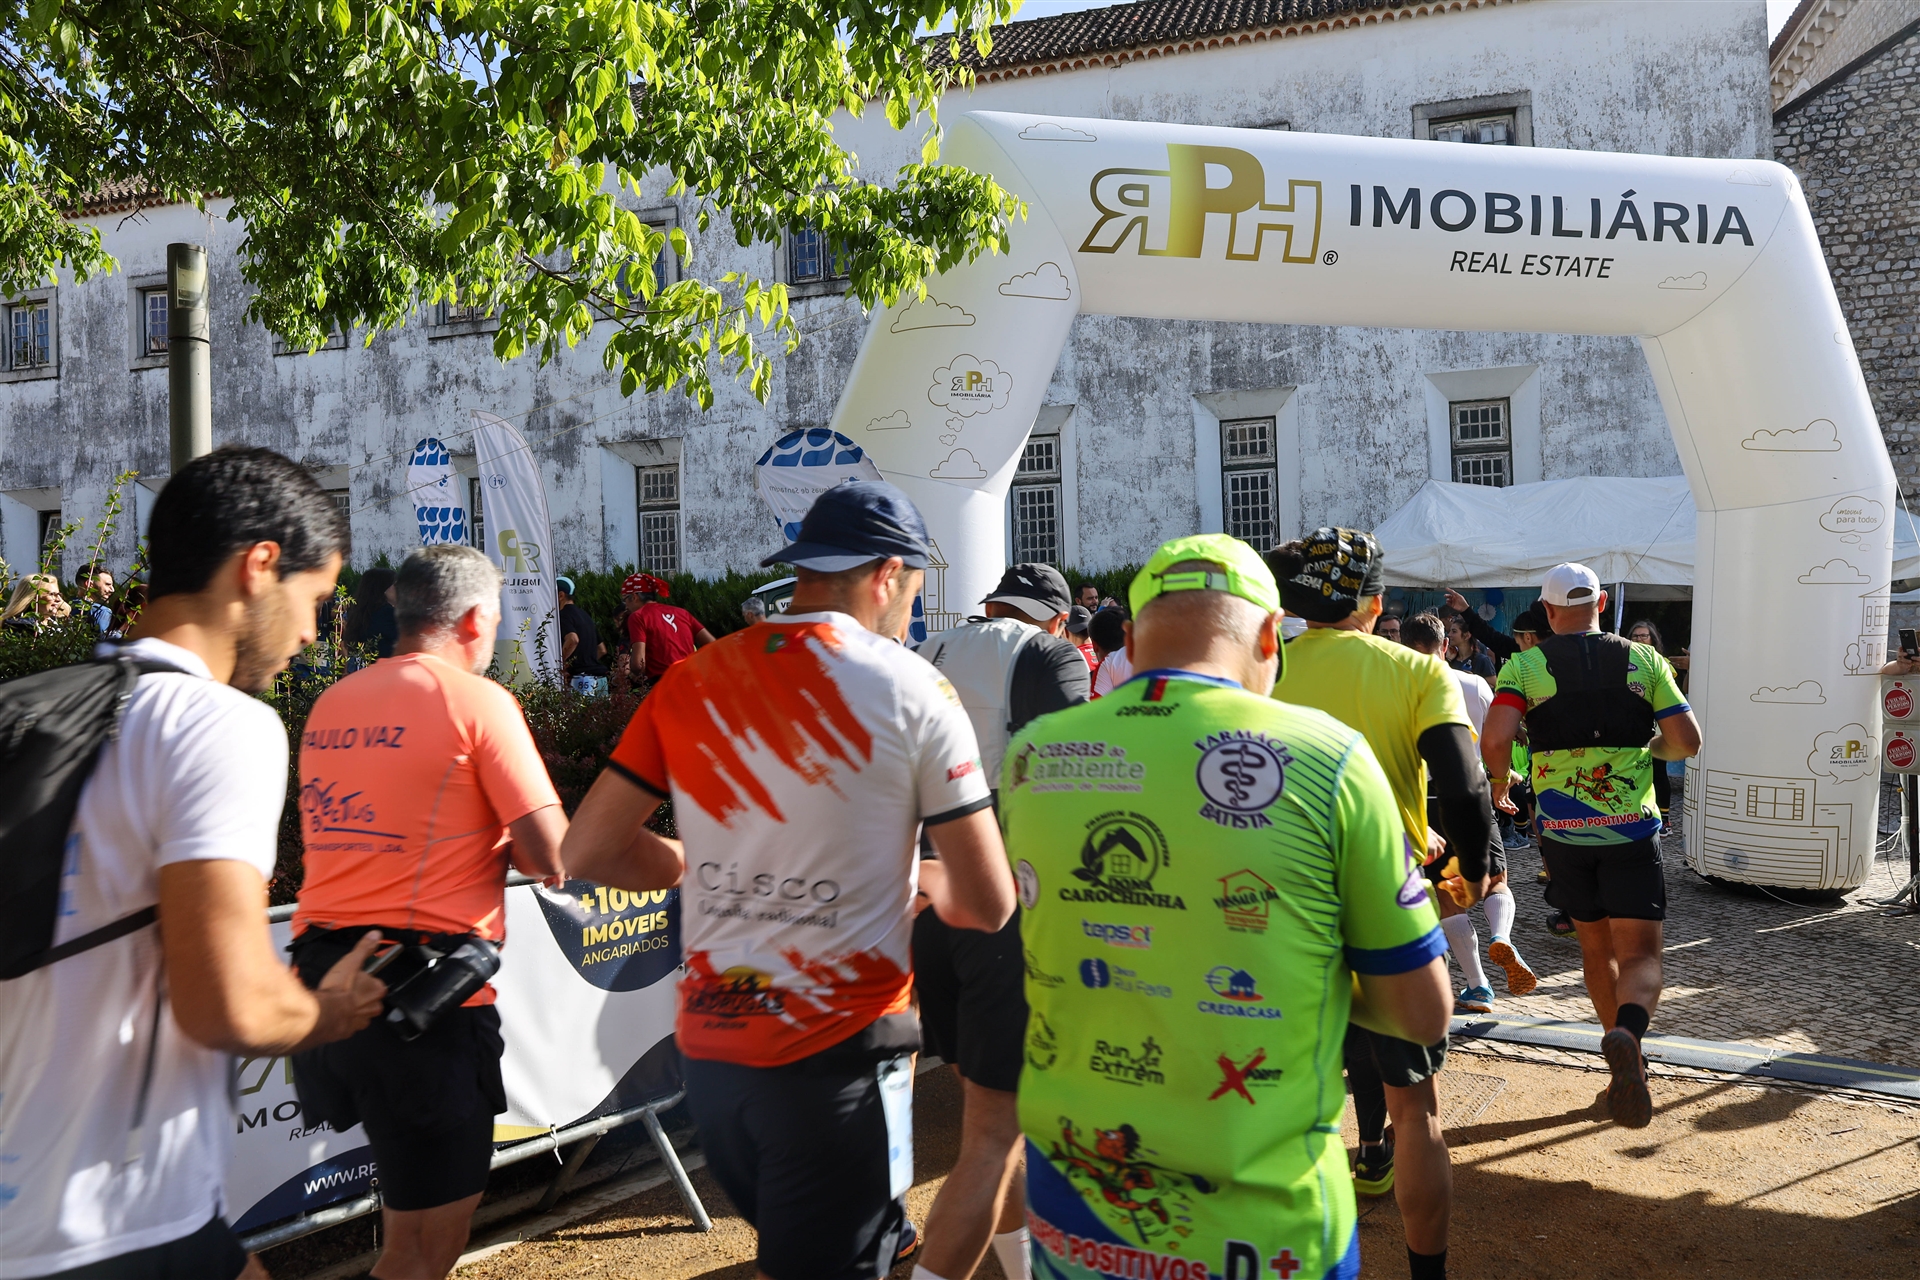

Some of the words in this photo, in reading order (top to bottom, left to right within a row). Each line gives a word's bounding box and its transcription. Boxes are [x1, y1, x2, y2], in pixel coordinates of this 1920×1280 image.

[1350, 184, 1754, 247] IMOBILIÁRIA
[1449, 250, 1513, 275] REAL
[1520, 253, 1615, 279] ESTATE
[1836, 517, 1856, 525] para
[1858, 516, 1878, 524] todos
[363, 726, 406, 748] VAZ
[1038, 741, 1107, 758] casas
[1033, 757, 1146, 780] ambiente
[1542, 817, 1585, 830] DESAFIOS
[1587, 812, 1640, 828] POSITIVOS
[697, 861, 841, 903] Cisco
[1059, 888, 1188, 911] CAROCHINHA
[582, 910, 669, 948] IMÓVEIS
[581, 935, 670, 968] ANGARIADOS
[1095, 1039, 1130, 1058] Run
[1068, 1234, 1208, 1280] POSITIVOS
